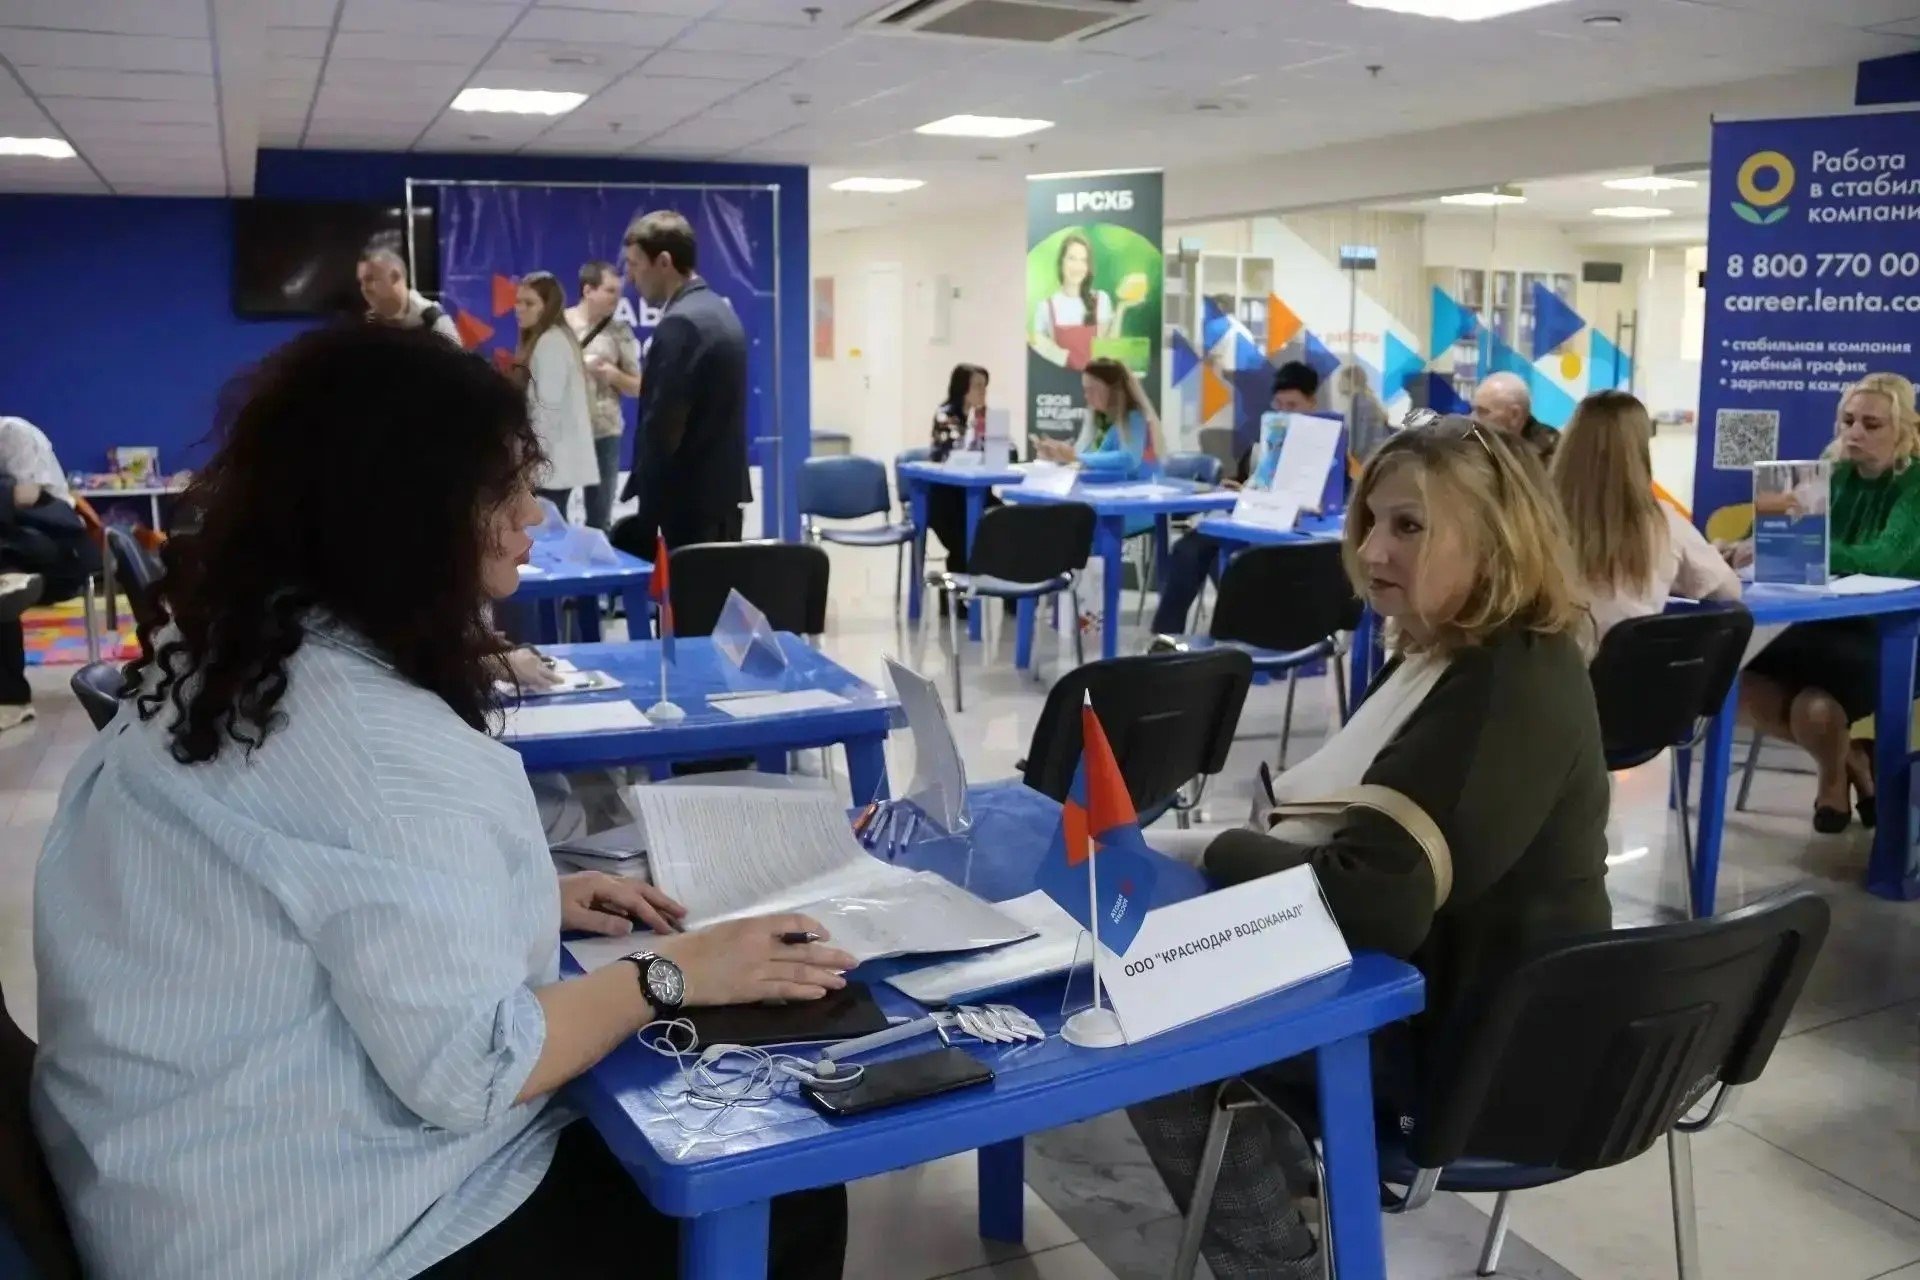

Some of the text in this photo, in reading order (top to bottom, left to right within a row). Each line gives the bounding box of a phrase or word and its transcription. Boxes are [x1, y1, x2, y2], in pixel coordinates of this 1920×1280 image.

[1811, 147, 1906, 173] Работа
[1076, 190, 1134, 212] РСХБ
[1809, 182, 1823, 198] в
[1726, 252, 1920, 278] 8 800 770 00
[1724, 286, 1920, 312] career.lenta.co
[1731, 336, 1912, 353] стабильная компания
[1730, 356, 1868, 375] удобный график
[1729, 378, 1805, 393] зарплата
[1124, 904, 1304, 977] ООО "КРАСНОДАР ВОДОКАНАЛ"
